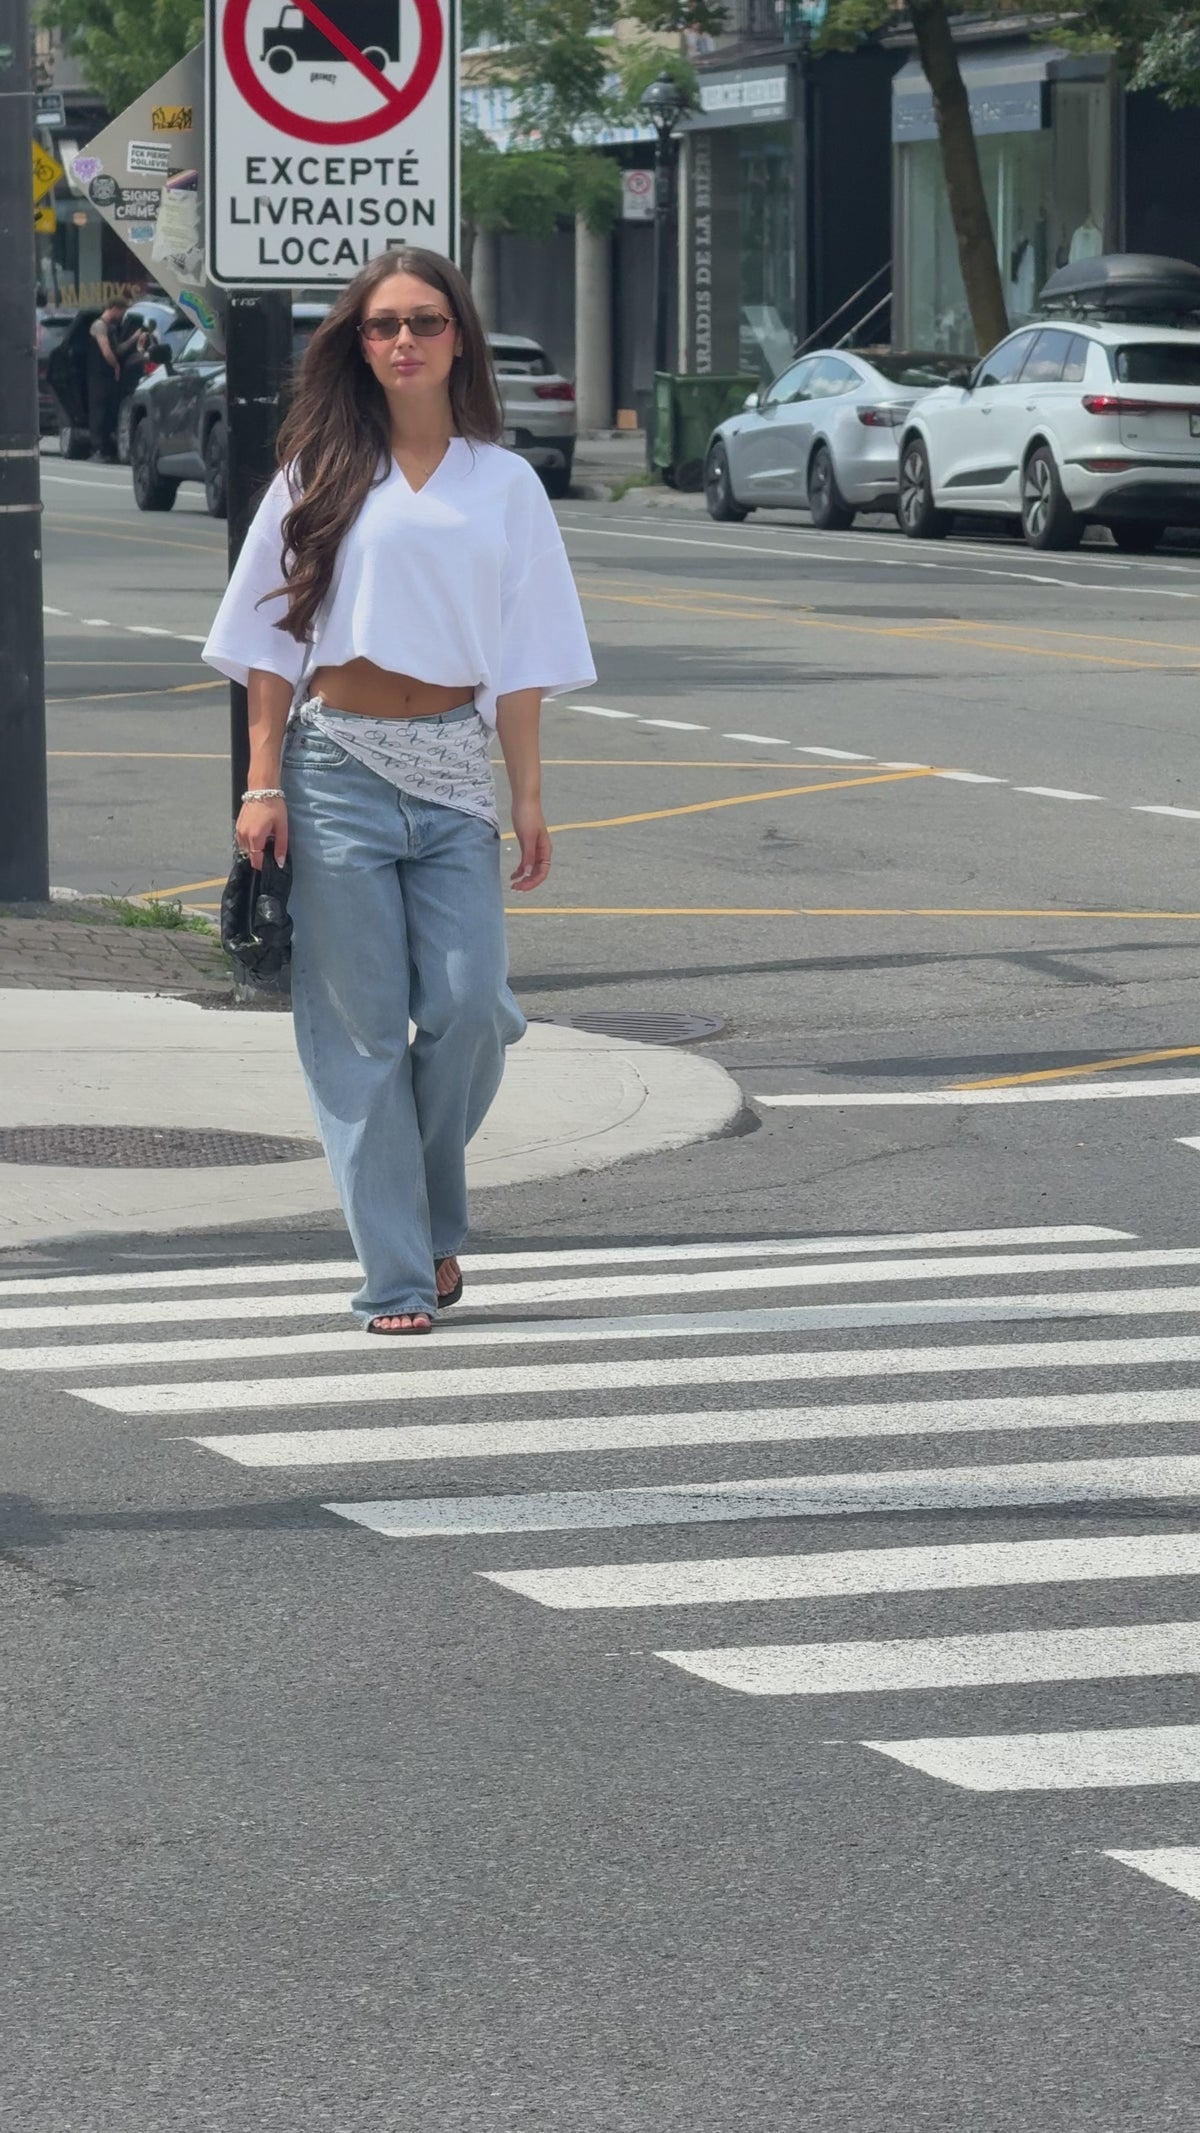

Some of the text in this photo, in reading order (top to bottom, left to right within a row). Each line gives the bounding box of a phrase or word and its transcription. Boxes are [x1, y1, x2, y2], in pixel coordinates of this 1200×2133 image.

[131, 158, 169, 168] POILIEVR
[246, 149, 419, 186] EXCEPTÉ
[121, 190, 160, 202] SIGNS
[230, 196, 435, 226] LIVRAISON
[695, 214, 712, 245] LA
[695, 251, 712, 285] DE
